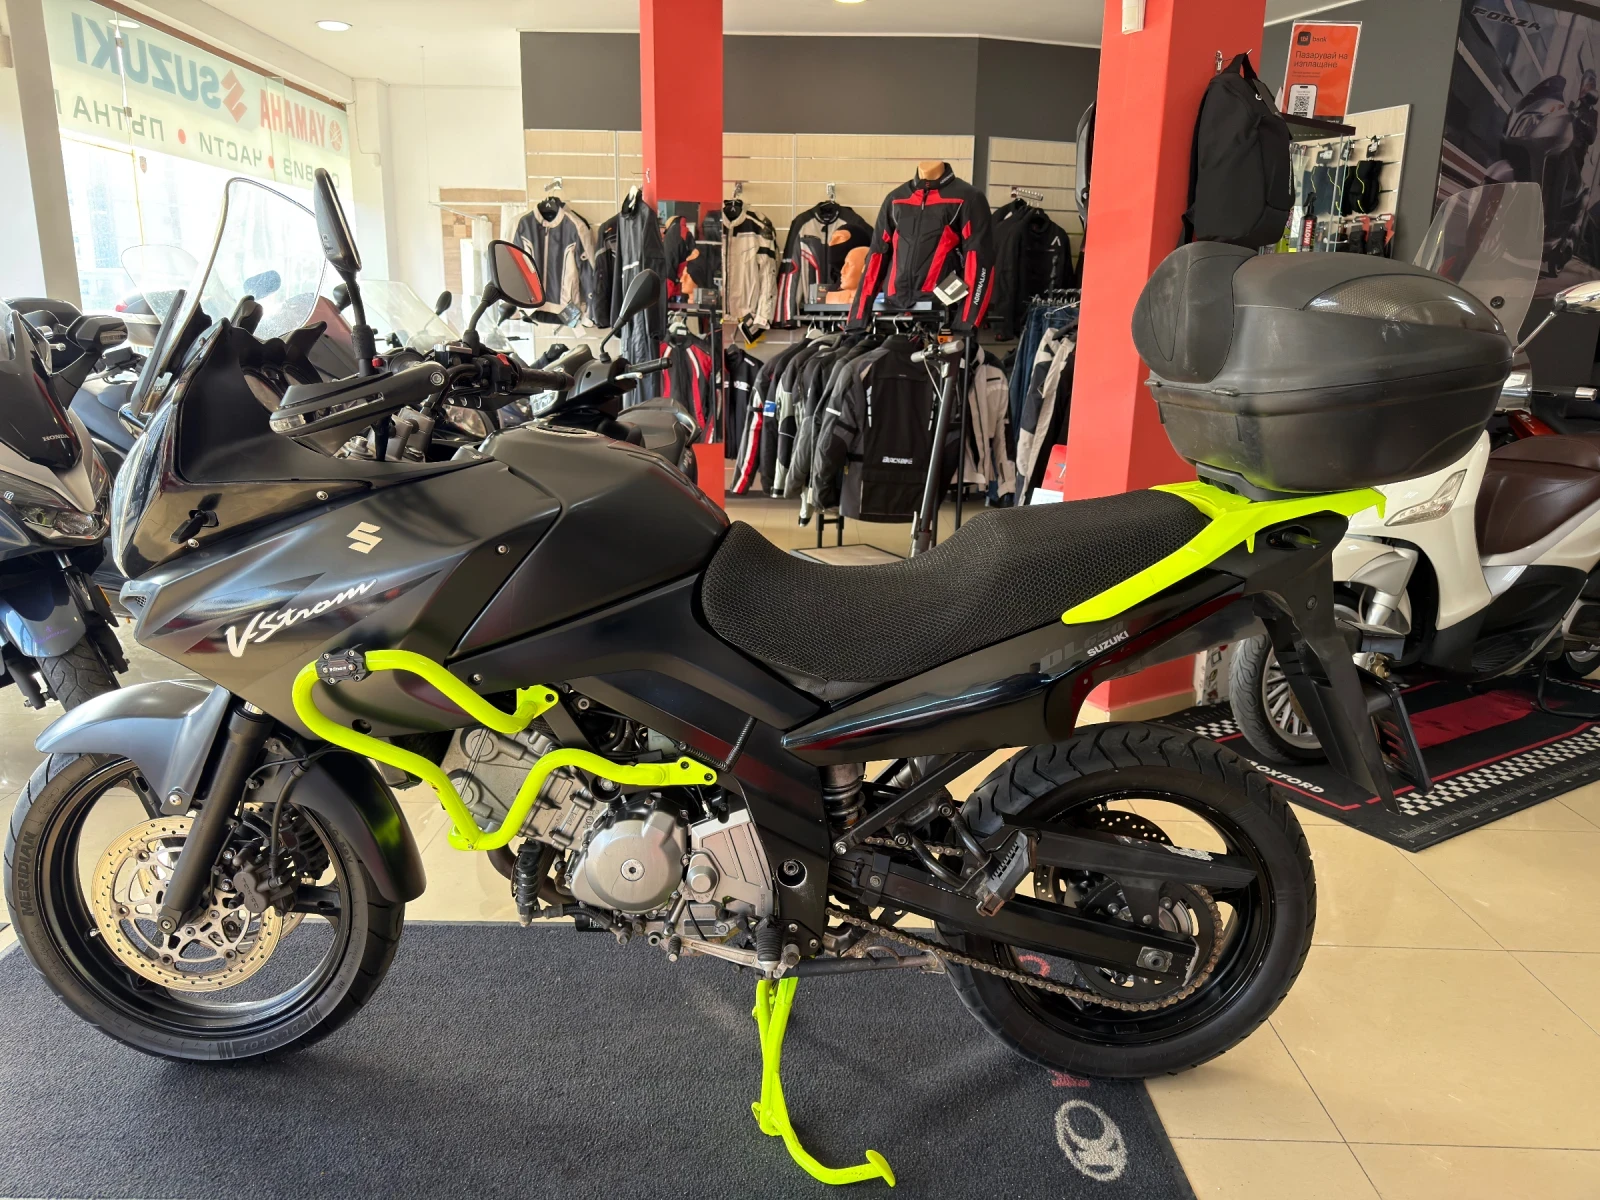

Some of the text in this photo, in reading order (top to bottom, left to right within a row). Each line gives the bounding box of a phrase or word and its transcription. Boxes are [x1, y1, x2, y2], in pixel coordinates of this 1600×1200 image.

[1471, 6, 1540, 31] FORZA
[1294, 60, 1338, 69] изплащане
[1295, 50, 1337, 60] Пазарувай
[1303, 220, 1313, 245] MOTUL
[42, 433, 69, 442] HONDA
[1086, 630, 1130, 657] SUZUKI
[1256, 765, 1325, 793] OXFORD
[18, 831, 37, 917] MERIDIAN
[239, 1023, 301, 1052] DUNLOP
